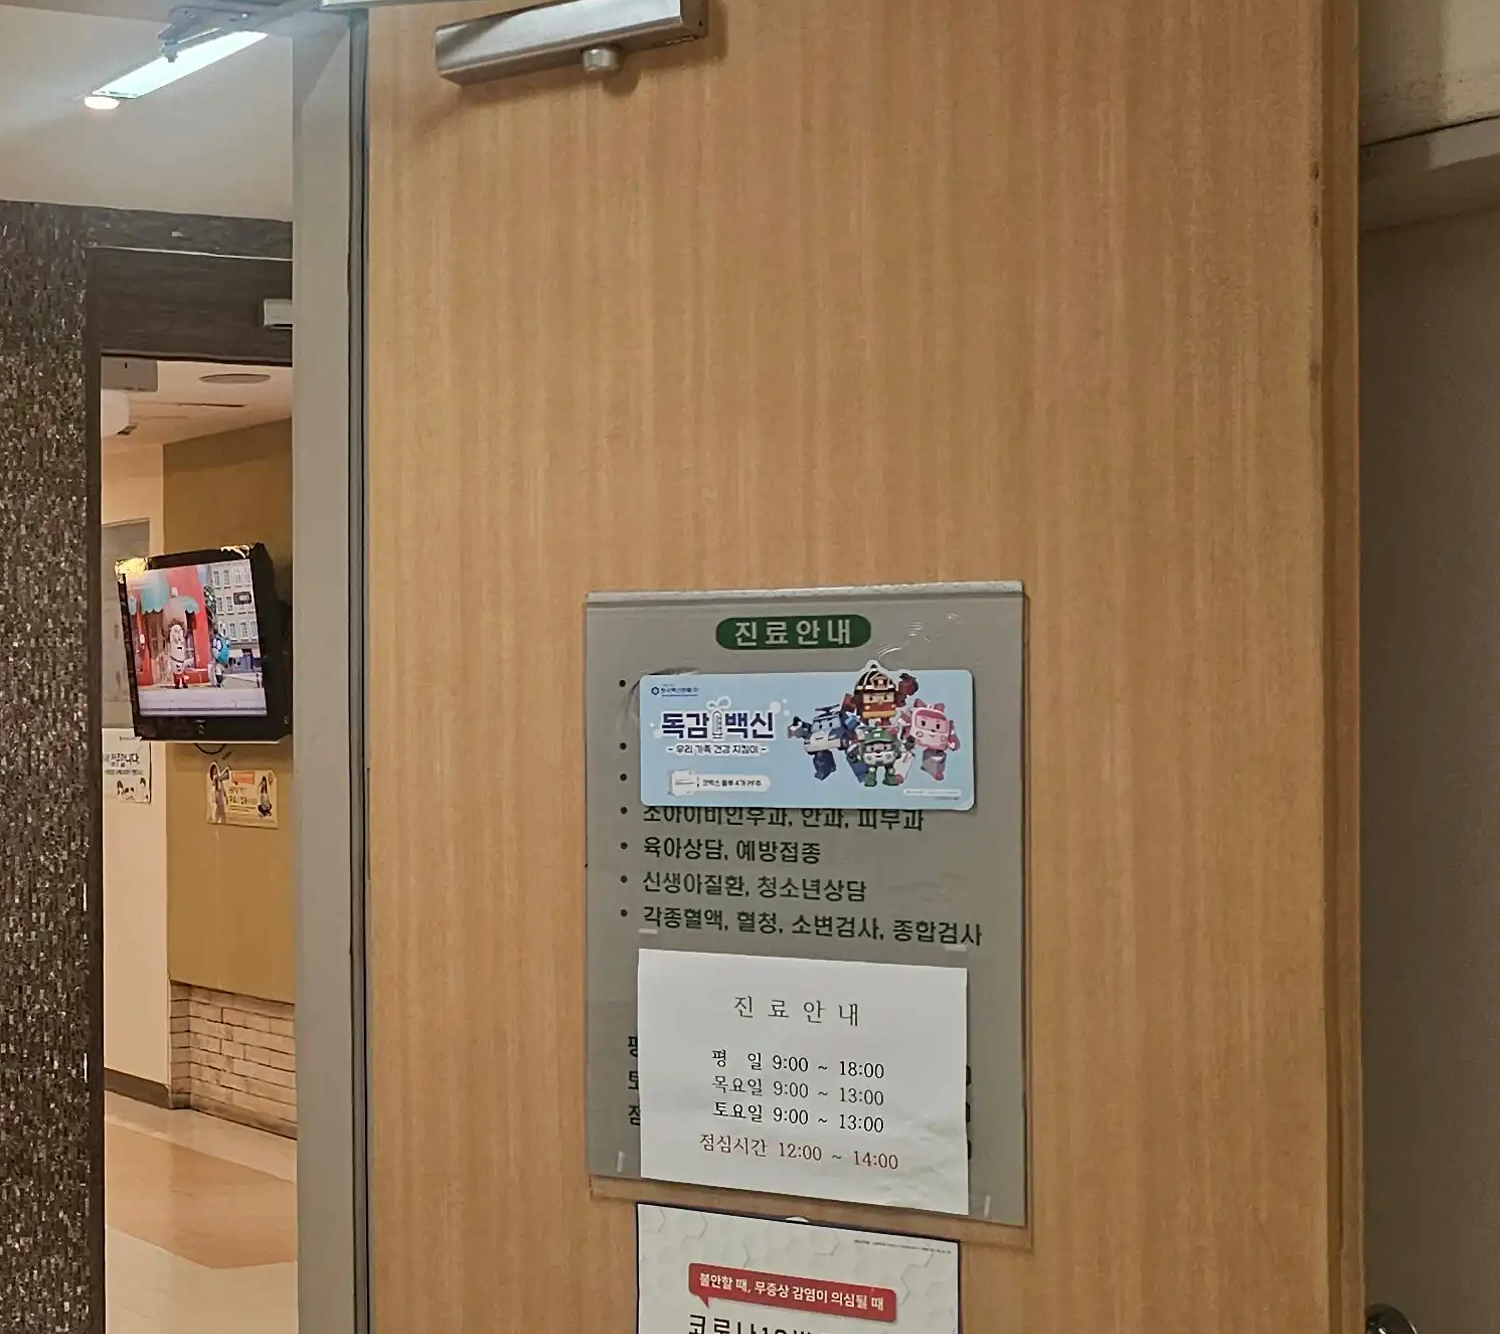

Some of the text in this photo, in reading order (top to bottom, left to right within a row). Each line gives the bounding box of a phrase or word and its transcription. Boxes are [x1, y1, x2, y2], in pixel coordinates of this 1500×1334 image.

[734, 618, 852, 647] 진료안내
[662, 712, 773, 739] 독감 백신
[643, 836, 821, 864] 육아상담, 예방접종
[643, 871, 867, 902] 신생아질환, 청소년상담
[643, 906, 983, 946] 각종혈액, 혈청, 소변검사, 종합검사
[772, 1054, 809, 1073] 9:00
[839, 1060, 885, 1079] 18:00
[712, 1075, 763, 1097] 목요일
[772, 1080, 809, 1099] 9:00
[839, 1087, 885, 1106] 13:00
[712, 1101, 763, 1124] 토요일
[772, 1107, 809, 1126] 9:00
[839, 1114, 885, 1133] 13:00
[699, 1133, 768, 1158] 점심시간
[778, 1141, 822, 1162] 12:00
[853, 1150, 899, 1170] 14:00
[700, 1273, 885, 1311] 불안할 때, 무증상 감염이 의심될 때
